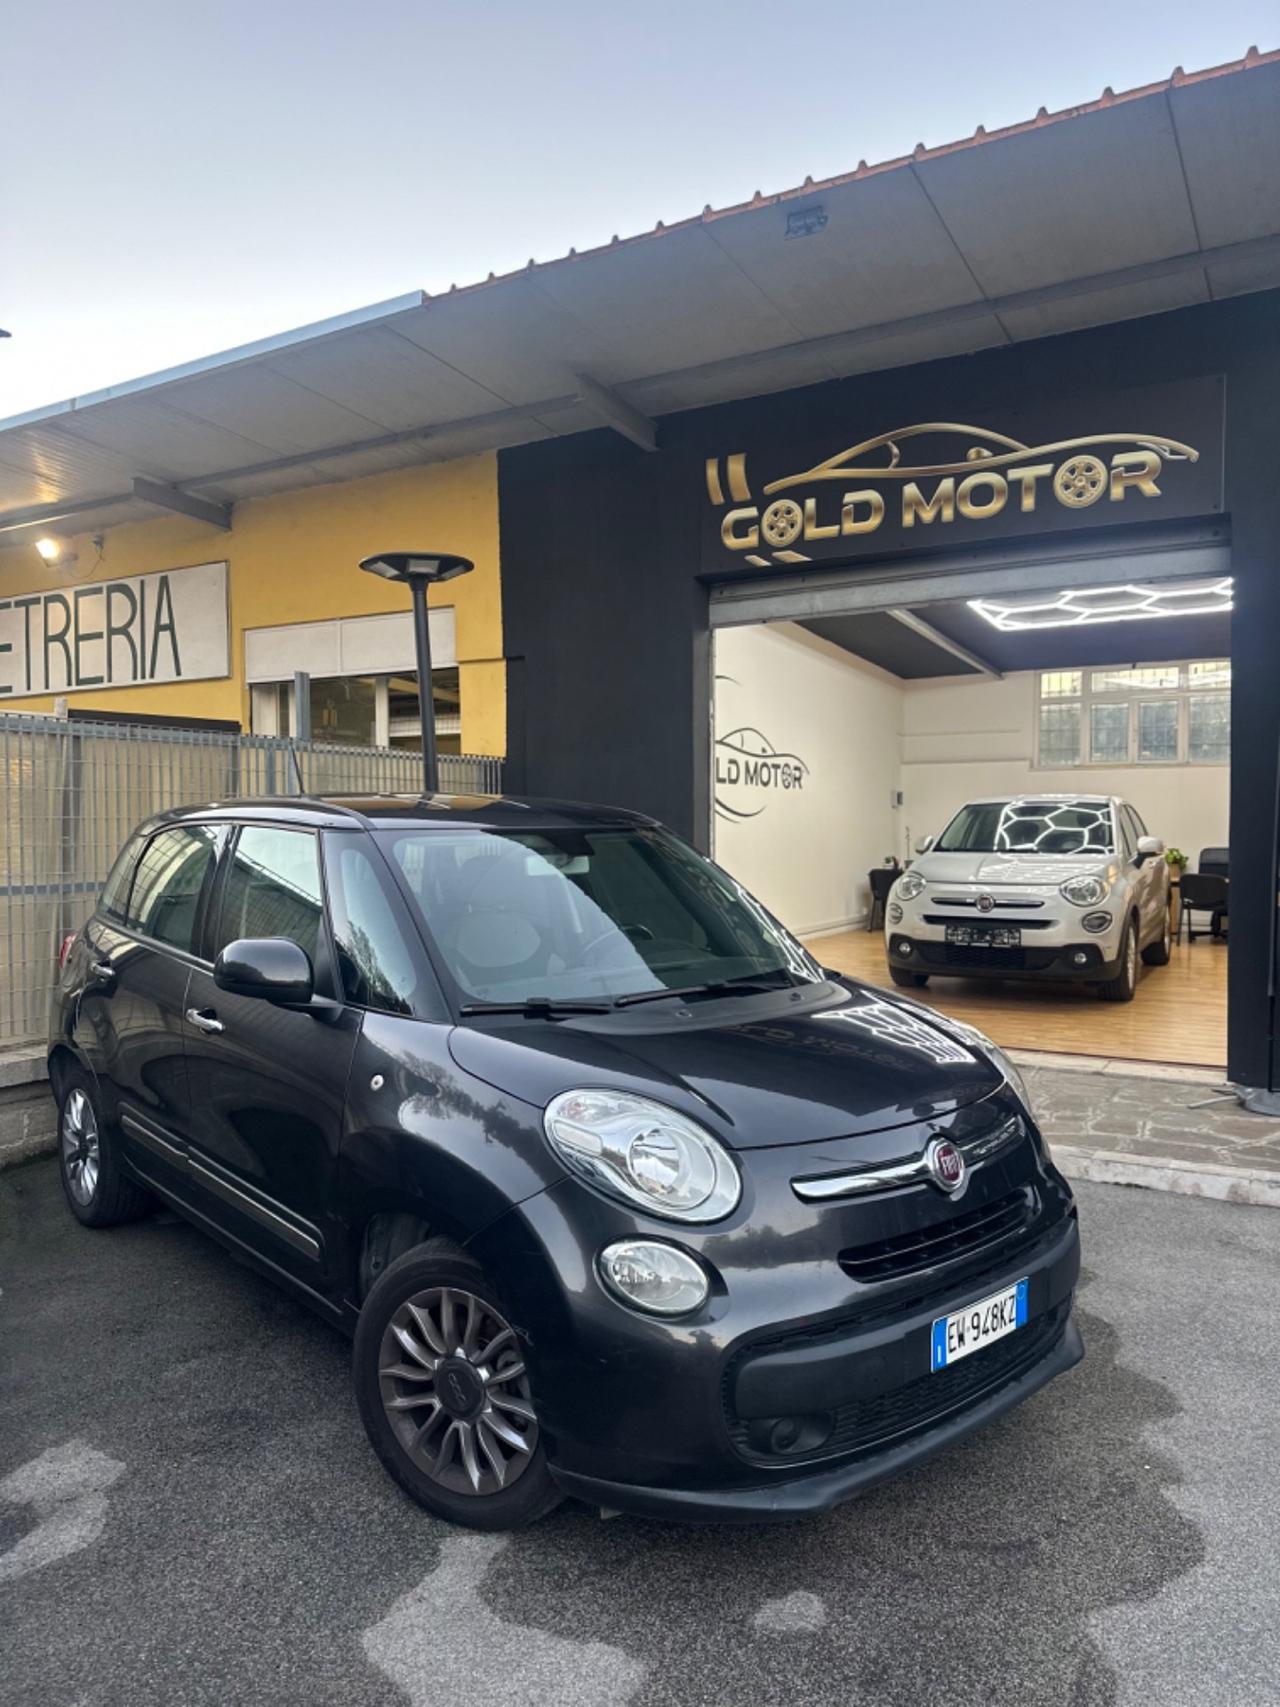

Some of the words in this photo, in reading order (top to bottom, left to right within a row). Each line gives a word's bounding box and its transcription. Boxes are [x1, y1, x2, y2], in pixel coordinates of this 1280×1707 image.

[720, 488, 885, 550] GOLD
[902, 450, 1163, 528] MOTOR
[744, 760, 804, 790] MOTOR
